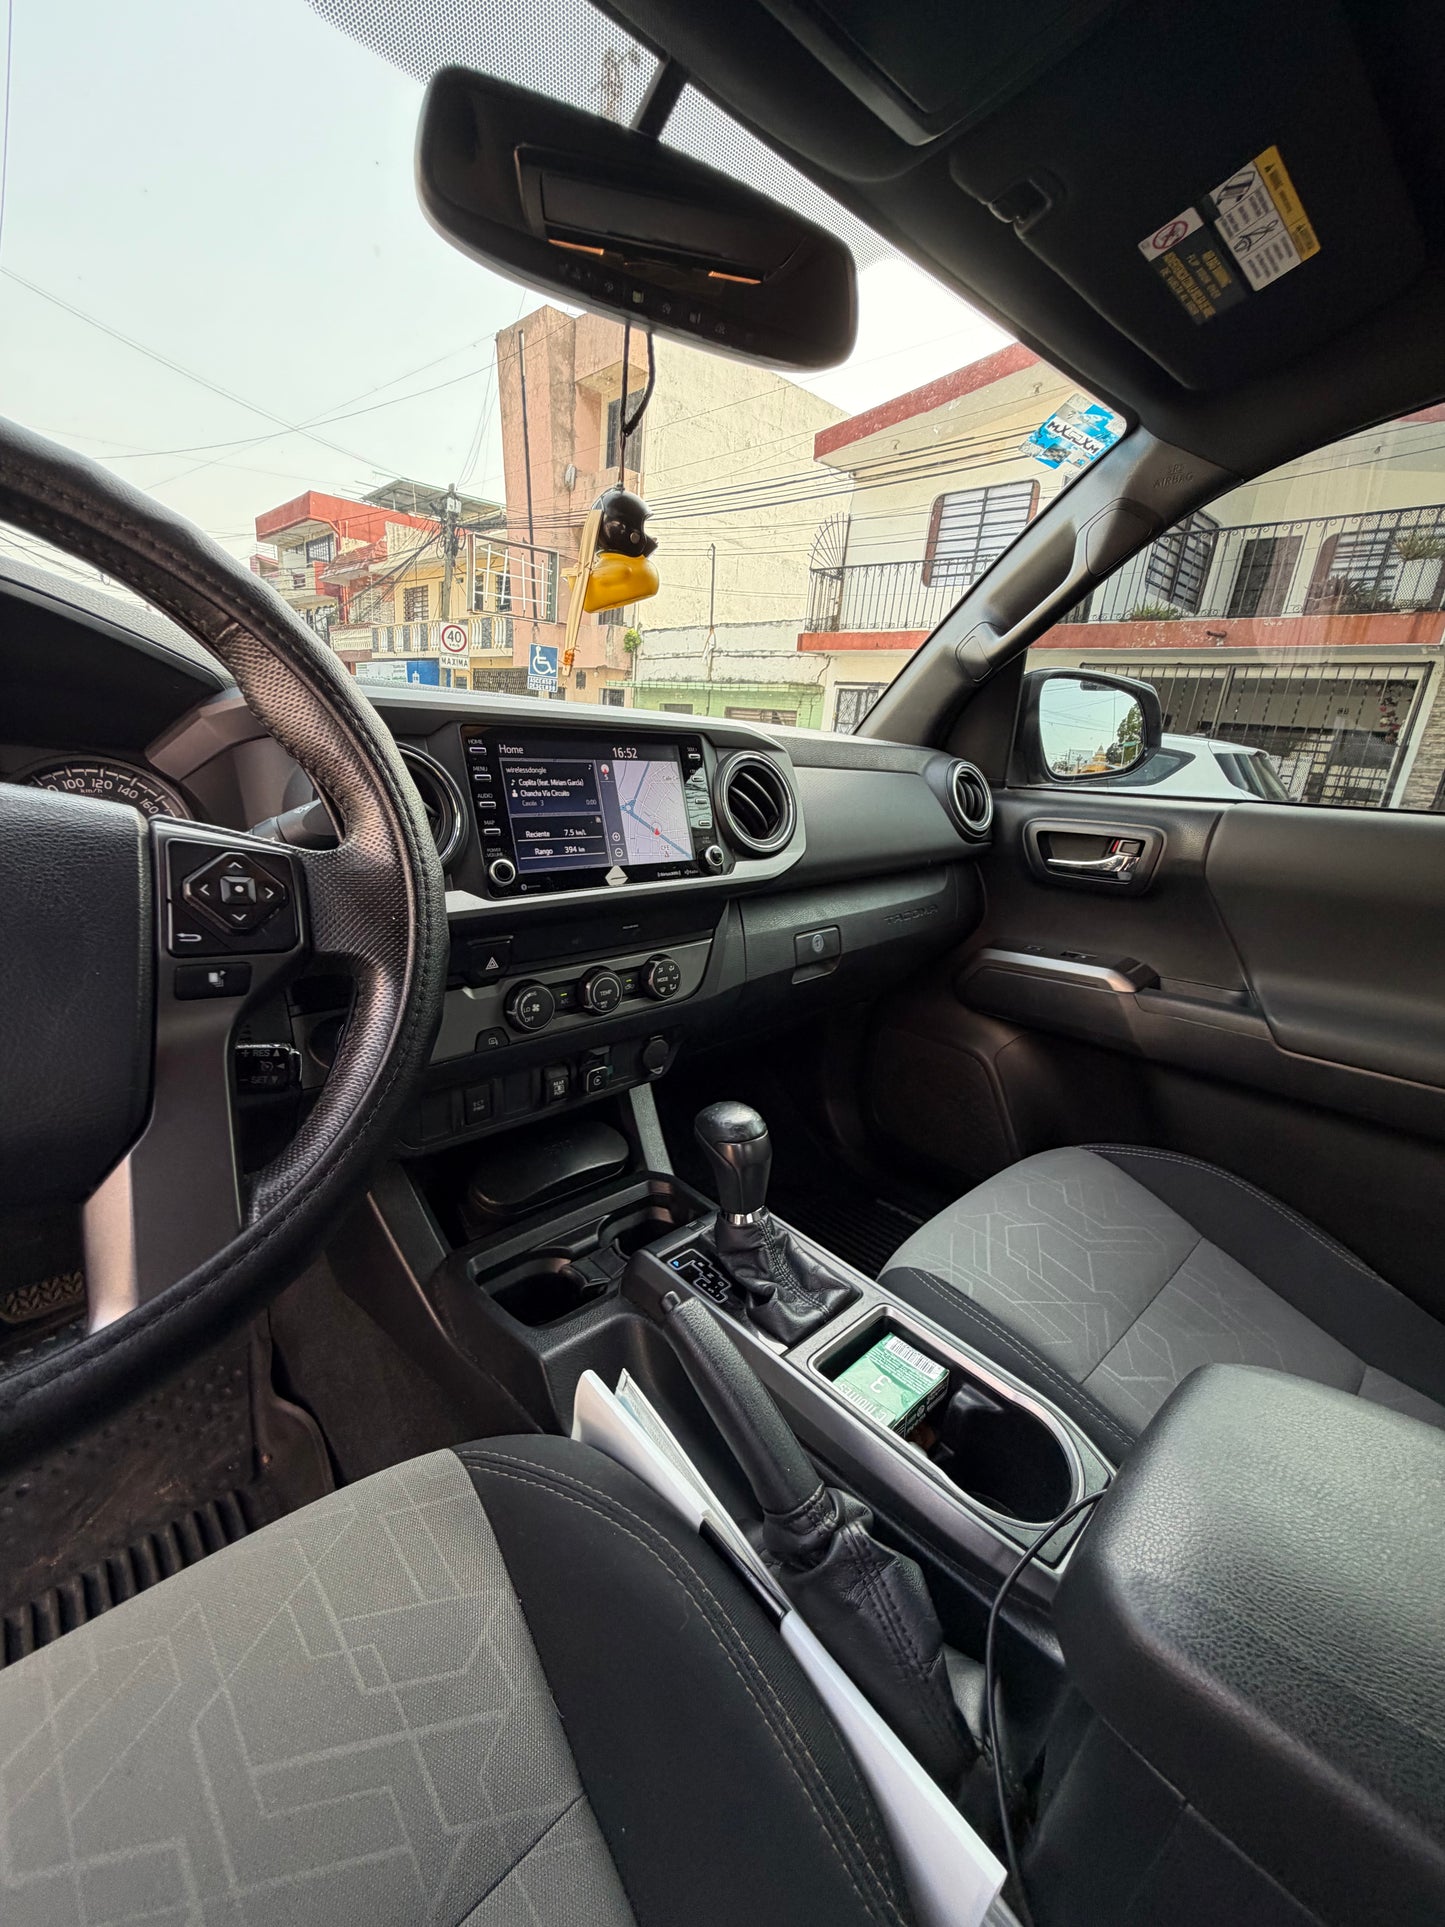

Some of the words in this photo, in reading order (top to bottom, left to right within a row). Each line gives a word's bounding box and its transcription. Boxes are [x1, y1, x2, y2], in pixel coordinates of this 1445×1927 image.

[447, 630, 462, 643] 40
[441, 656, 469, 667] MAXIMA
[499, 744, 524, 754] Home
[612, 747, 638, 759] 16:52
[505, 766, 547, 775] wirelessdongle
[62, 777, 85, 791] 100
[91, 778, 113, 790] 120
[117, 784, 139, 800] 140
[139, 798, 160, 814] 160
[534, 848, 553, 856] Rango
[251, 1076, 268, 1084] SET
[869, 1374, 893, 1394] 3
